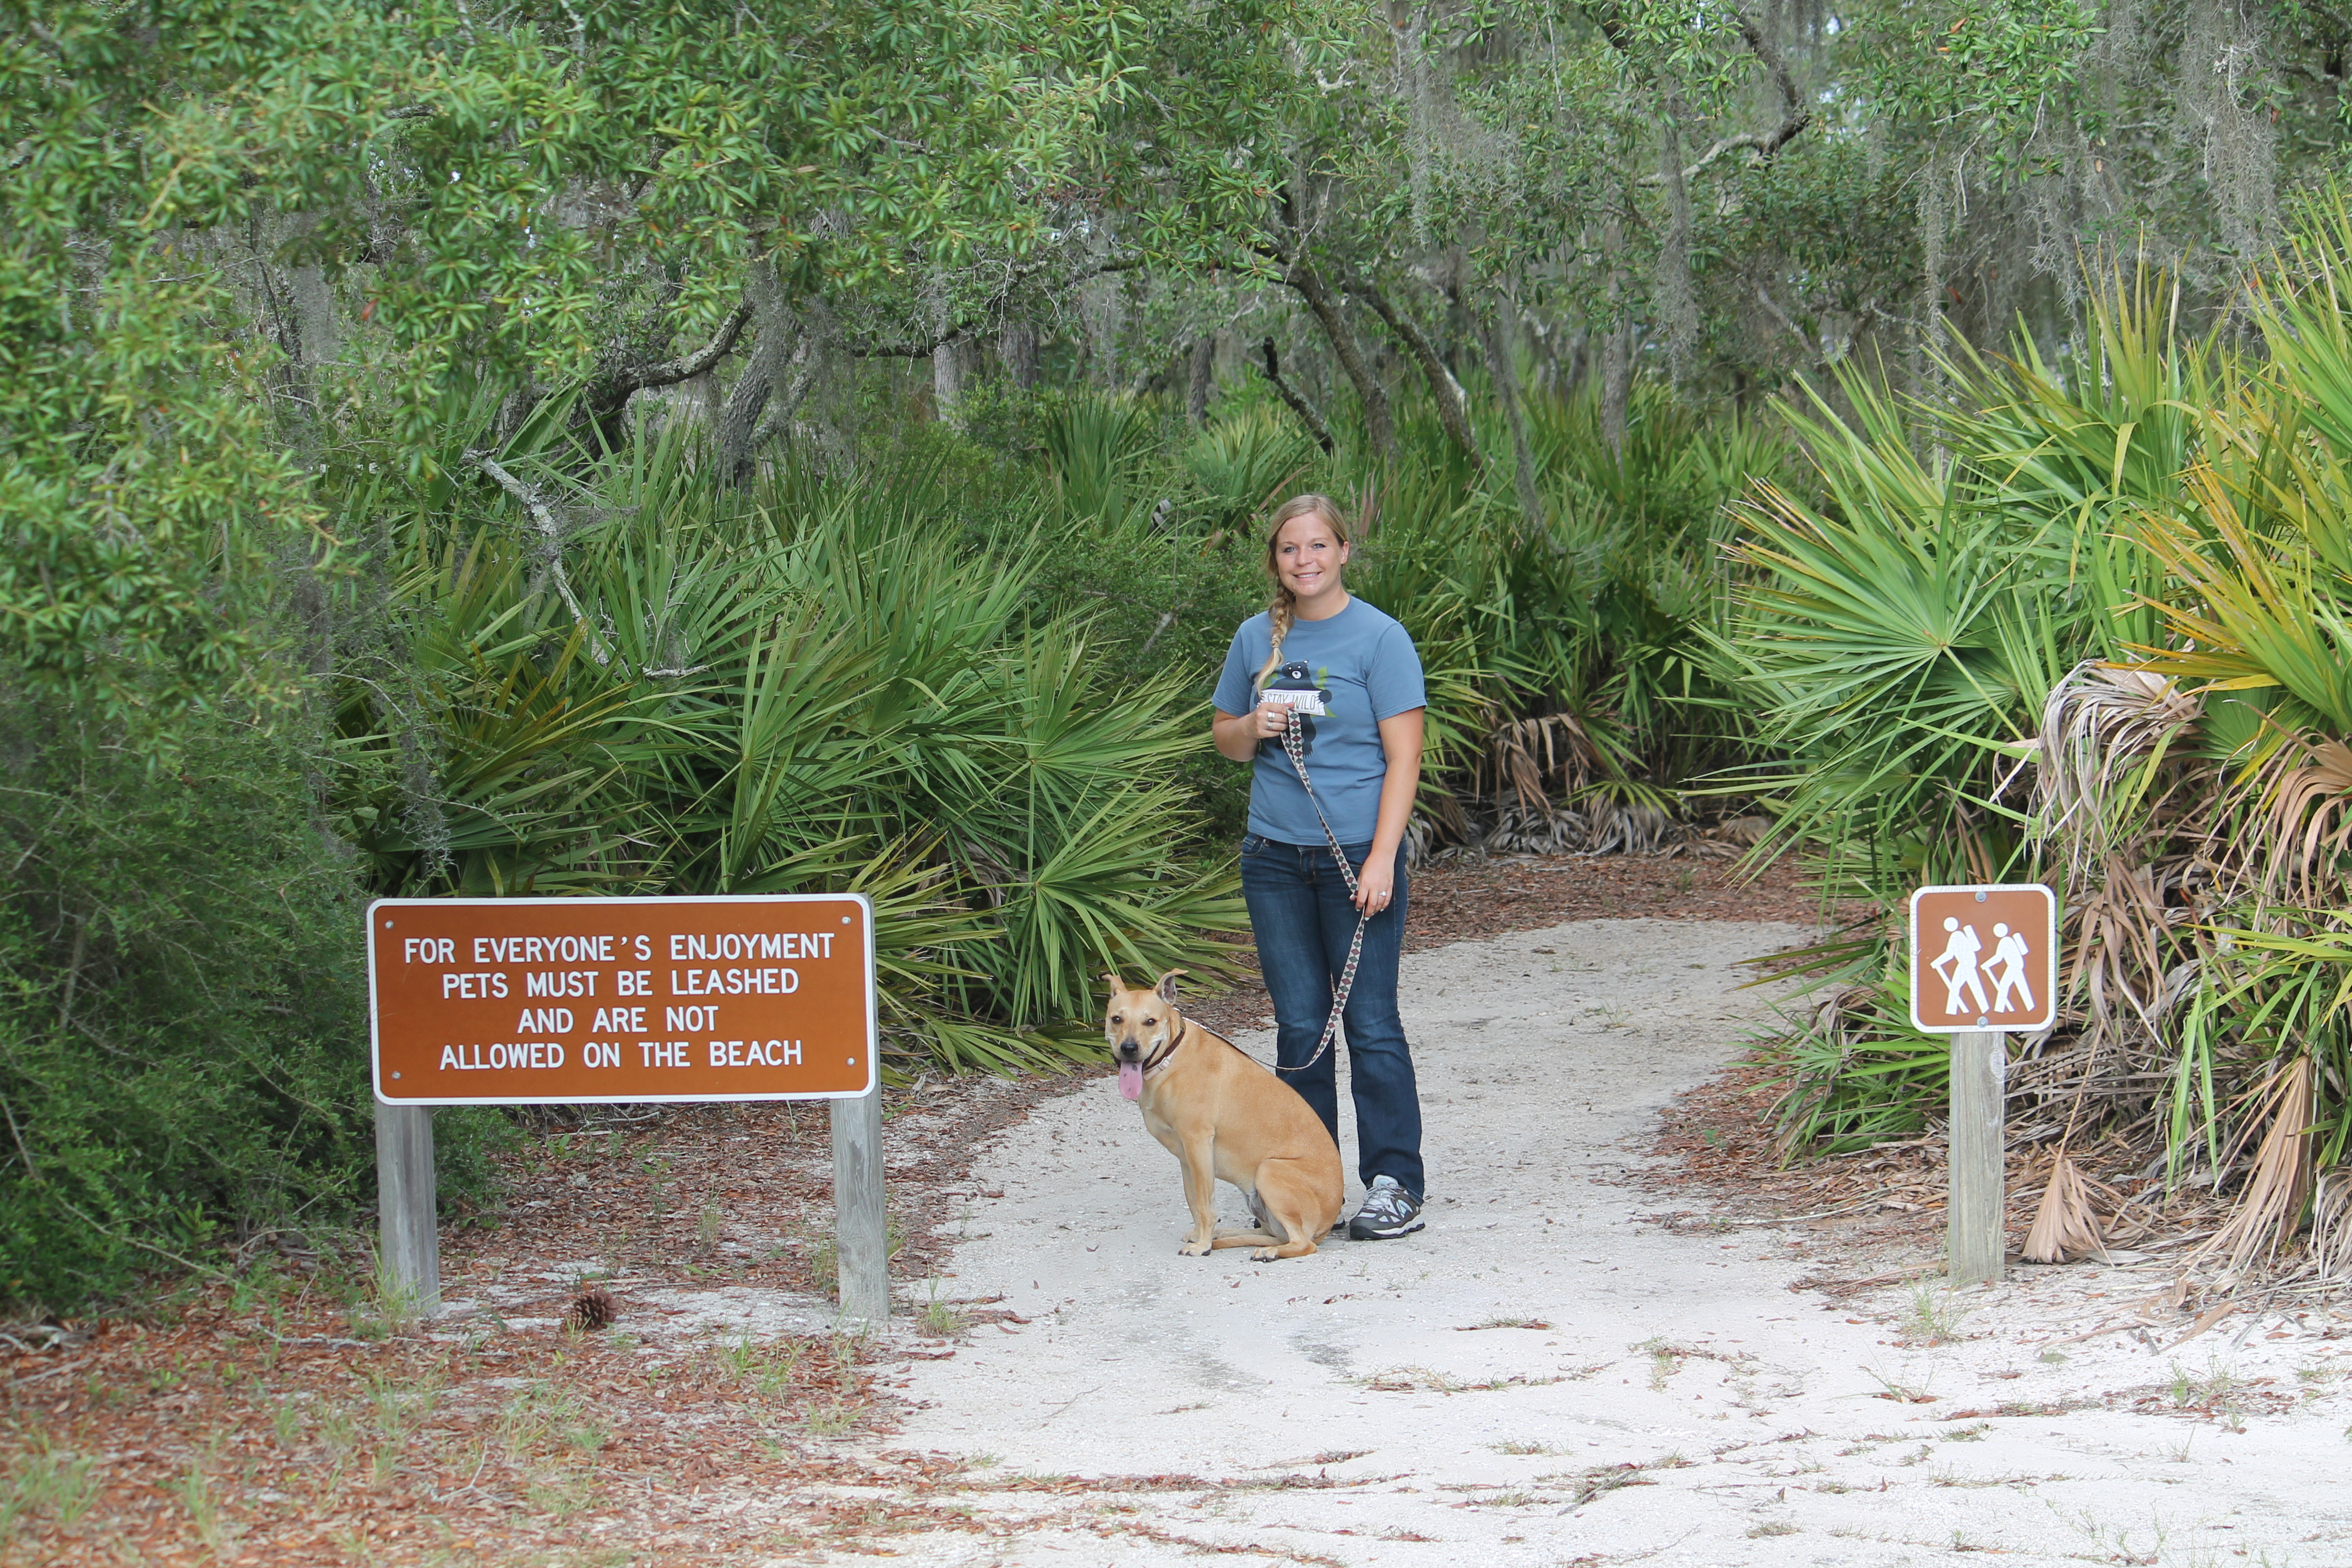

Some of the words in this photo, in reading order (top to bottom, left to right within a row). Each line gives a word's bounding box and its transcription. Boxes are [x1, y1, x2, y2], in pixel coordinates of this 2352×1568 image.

[1267, 693, 1289, 705] STAY
[1292, 694, 1316, 710] WILD
[405, 938, 455, 963] FOR
[474, 934, 652, 962] EVERYONE'S
[671, 933, 835, 960] ENJOYMENT
[443, 973, 509, 999] PETS
[527, 971, 598, 997] MUST
[618, 970, 653, 996] BE
[671, 968, 799, 995] LEASHED
[518, 1008, 574, 1033] AND
[592, 1007, 648, 1033] ARE
[666, 1005, 719, 1032] NOT
[440, 1043, 565, 1070] ALLOWED
[584, 1042, 620, 1068] ON
[639, 1042, 691, 1068] THE
[710, 1040, 802, 1066] BEACH
